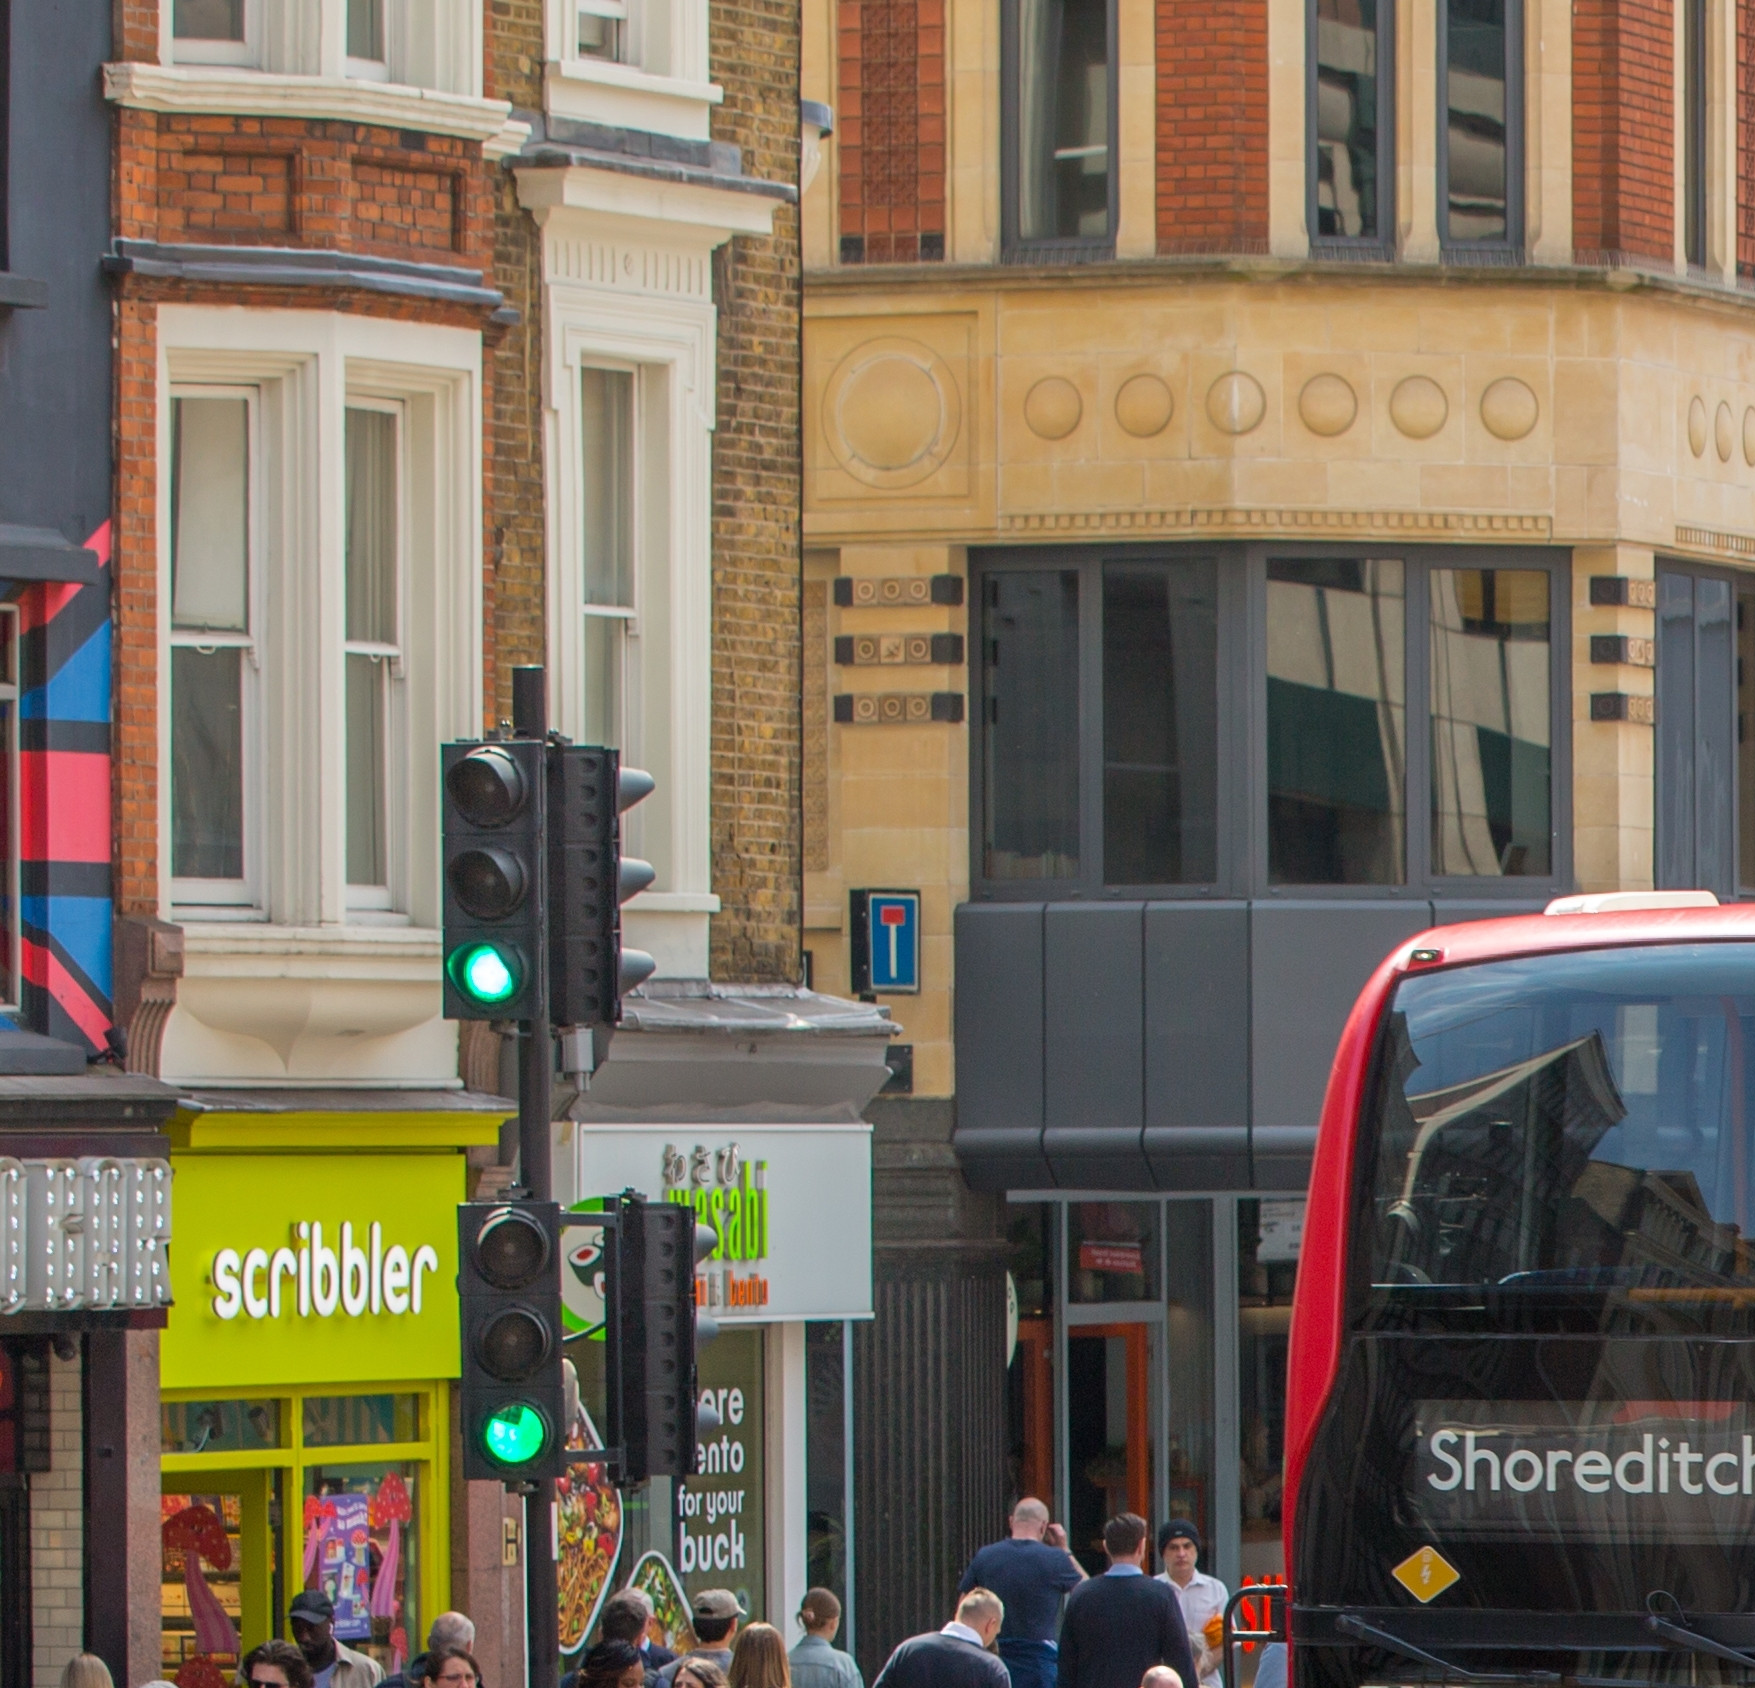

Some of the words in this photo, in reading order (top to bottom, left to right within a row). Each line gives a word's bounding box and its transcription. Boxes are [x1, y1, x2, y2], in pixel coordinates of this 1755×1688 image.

[662, 1142, 741, 1185] わさび
[212, 1220, 439, 1321] scribbler
[697, 1435, 745, 1475] ento
[678, 1485, 703, 1517] for
[706, 1489, 745, 1524] your
[680, 1519, 745, 1574] buck
